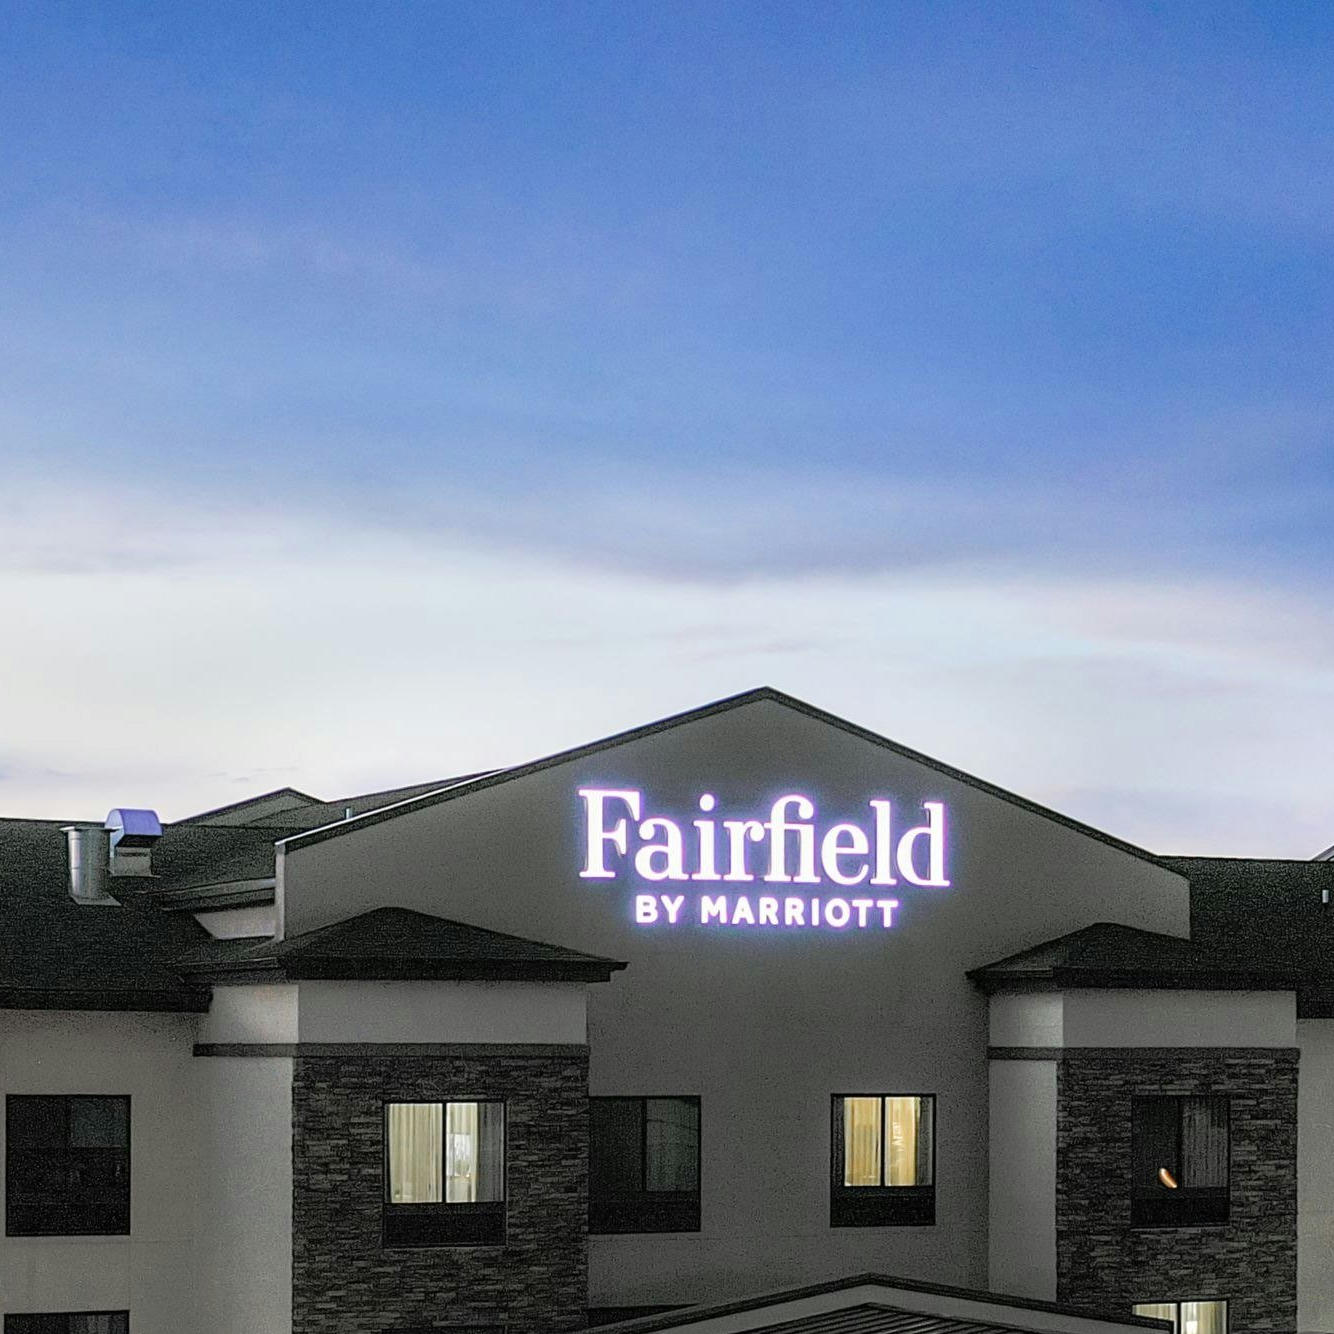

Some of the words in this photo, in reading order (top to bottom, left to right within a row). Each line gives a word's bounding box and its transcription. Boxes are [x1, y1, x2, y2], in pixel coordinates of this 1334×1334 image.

[578, 788, 951, 887] Fairfield
[635, 894, 686, 924] BY
[700, 896, 900, 929] MARRIOTT
